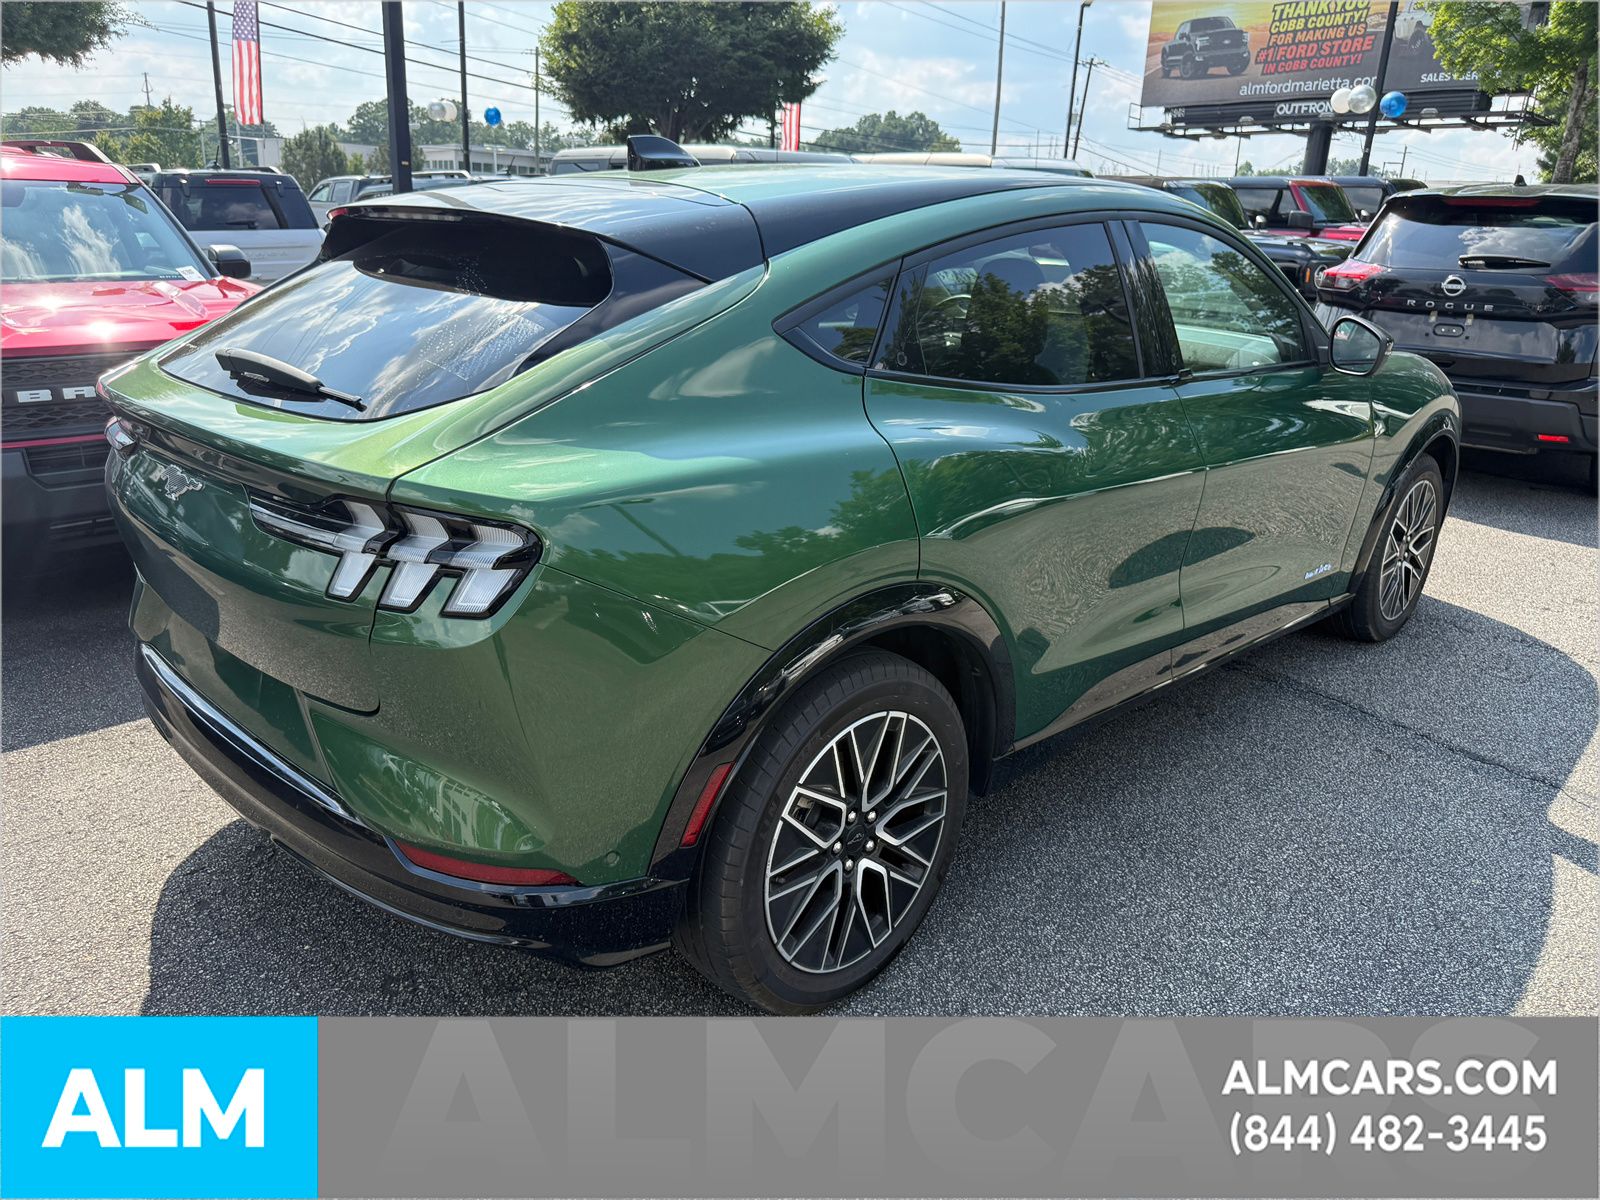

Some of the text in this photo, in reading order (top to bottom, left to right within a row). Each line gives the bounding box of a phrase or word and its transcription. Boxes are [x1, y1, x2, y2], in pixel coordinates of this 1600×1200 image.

[1273, 1, 1369, 20] THANK YOU
[1271, 9, 1368, 33] COBB COUNTY!
[1269, 23, 1367, 46] FOR MAKING US
[1257, 35, 1376, 63] #1 FORD STORE
[1263, 53, 1363, 75] IN COBB COUNTY!
[1420, 72, 1451, 83] SALES
[1276, 101, 1335, 115] OUTFRON
[1406, 299, 1494, 312] ROGUE
